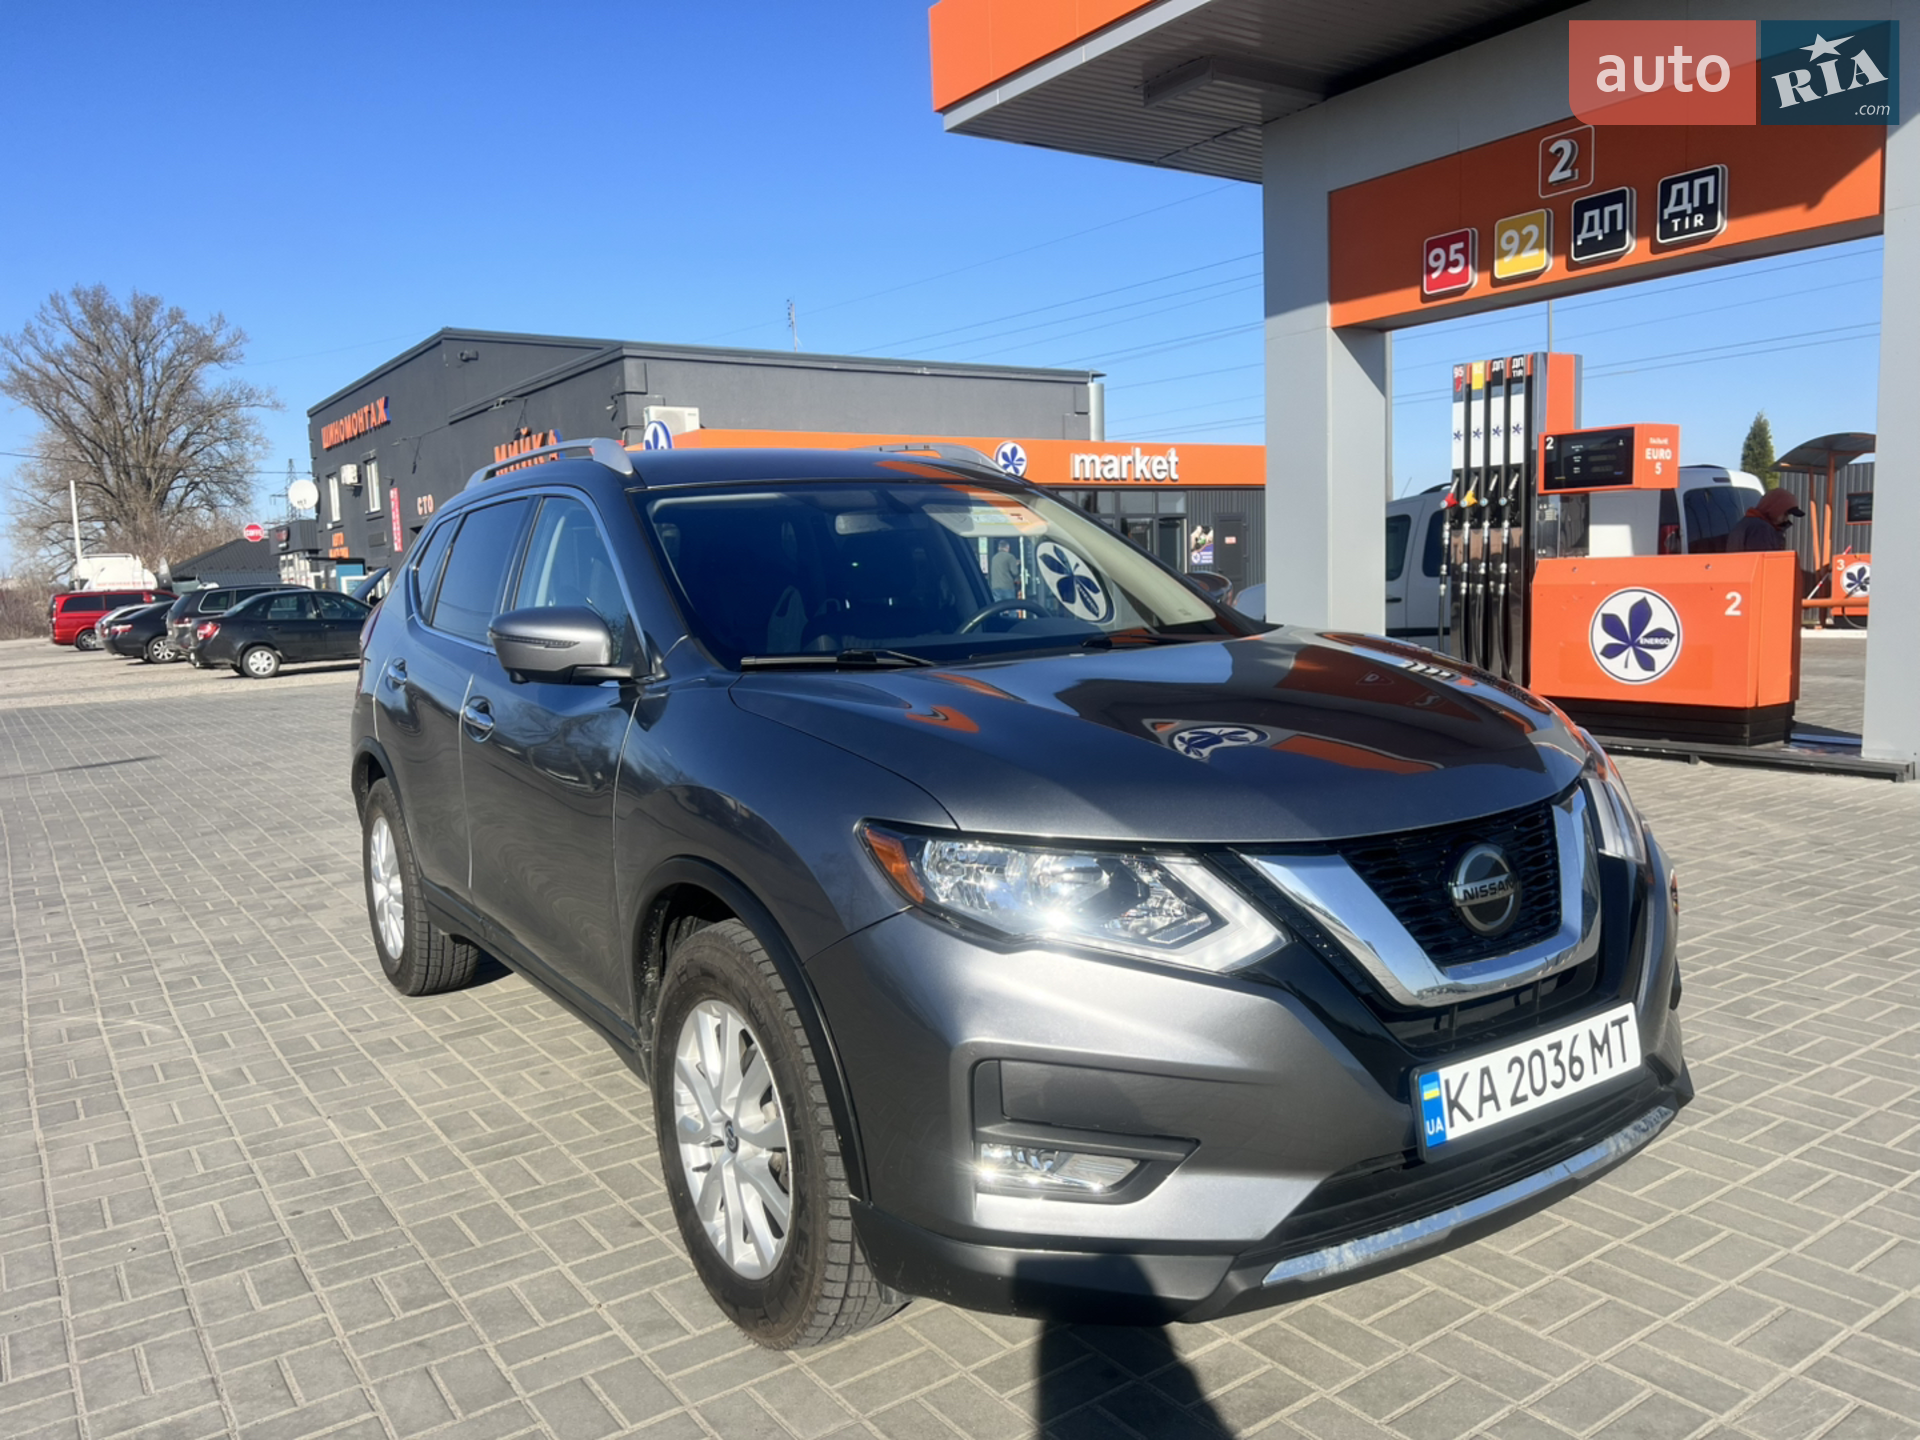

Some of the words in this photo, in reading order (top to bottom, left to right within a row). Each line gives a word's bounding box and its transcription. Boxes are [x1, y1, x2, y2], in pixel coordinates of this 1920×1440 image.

[1548, 139, 1577, 184] 2
[1663, 174, 1716, 220] ДП
[1576, 202, 1624, 246] ДП
[1671, 213, 1705, 232] TIR
[1500, 224, 1540, 263] 92
[1428, 242, 1466, 280] 95
[321, 396, 388, 449] ШИНОМОНТАЖ
[1546, 436, 1554, 450] 2
[1645, 447, 1672, 460] EURO
[1072, 447, 1179, 481] market
[1655, 461, 1663, 475] 5
[417, 494, 434, 516] СТО
[1837, 559, 1845, 571] 3
[1724, 591, 1742, 616] 2
[1639, 637, 1671, 646] ENERGO
[1463, 879, 1515, 901] NISSAN
[1444, 1065, 1502, 1128] KA
[1507, 1033, 1585, 1107] 2036
[1588, 1015, 1630, 1075] MT
[1426, 1117, 1445, 1136] UA
